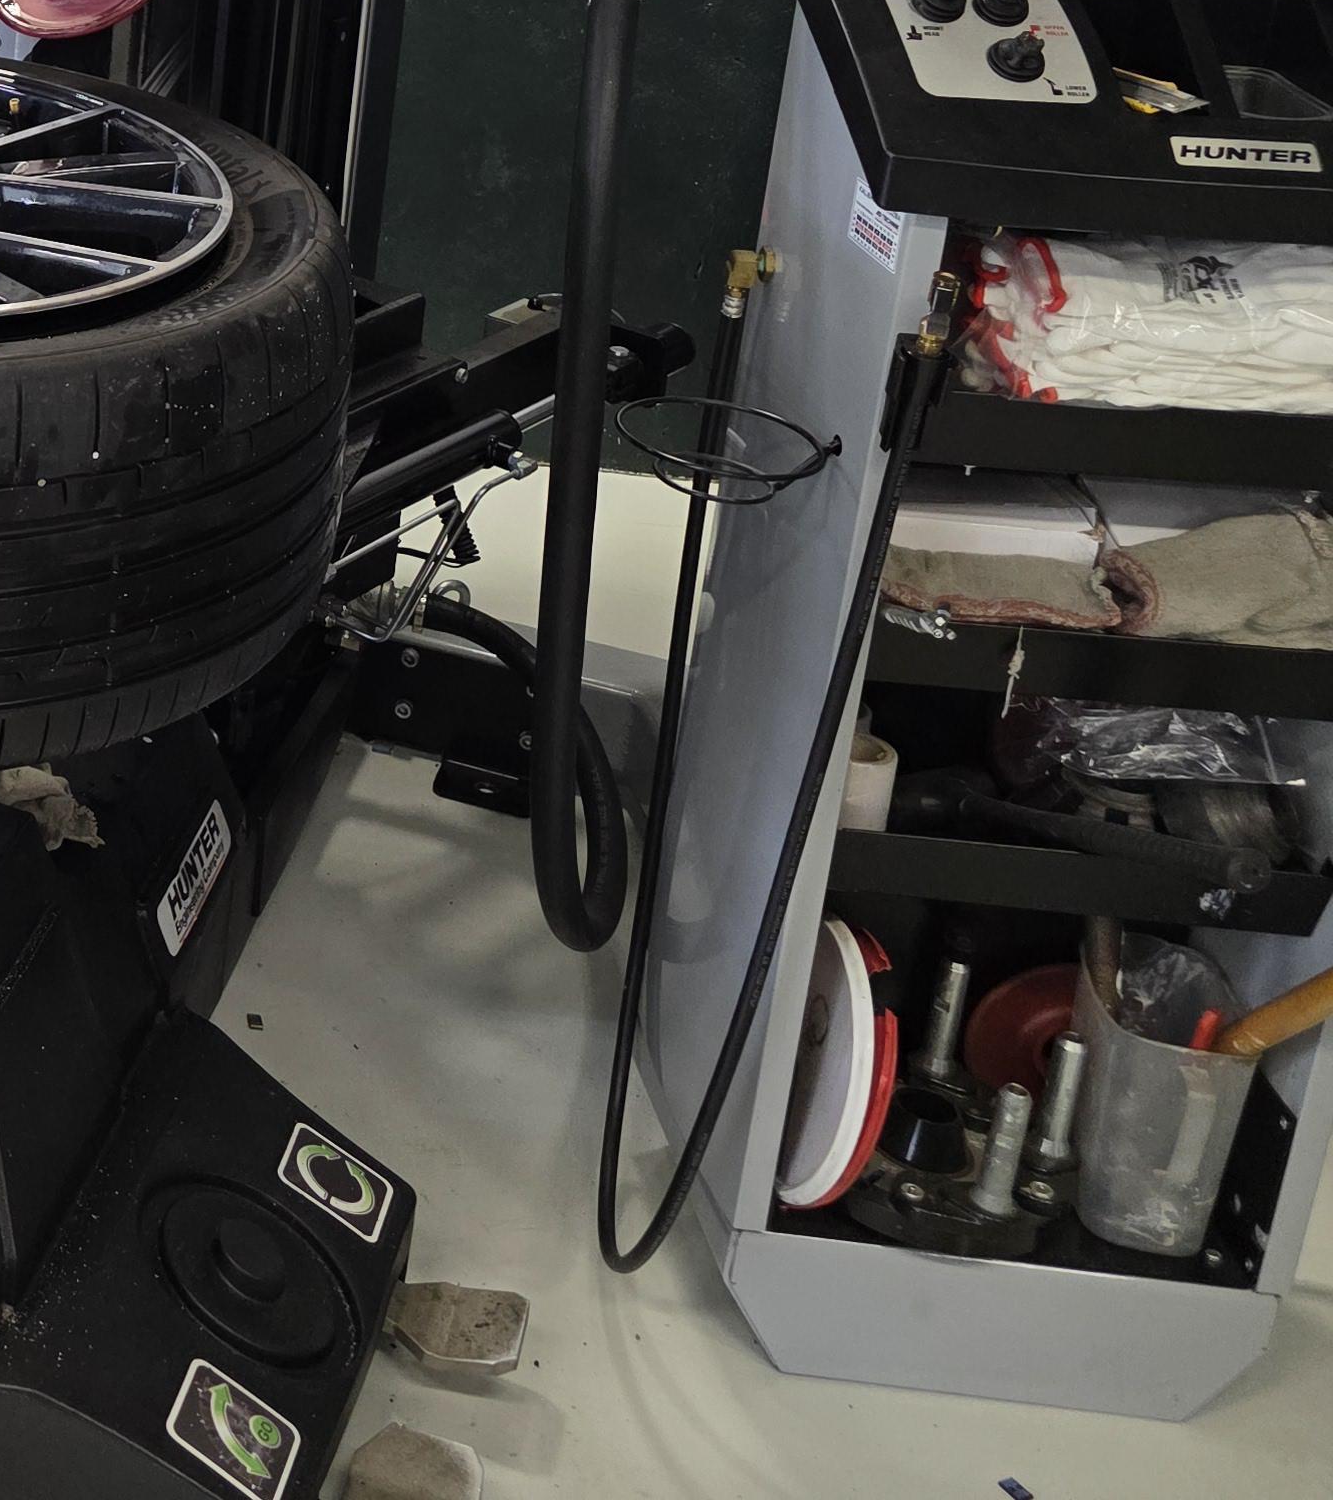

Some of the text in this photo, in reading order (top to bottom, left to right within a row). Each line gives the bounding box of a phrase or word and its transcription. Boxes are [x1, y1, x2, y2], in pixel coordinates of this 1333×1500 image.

[1180, 145, 1311, 164] HUNTER
[166, 811, 221, 922] HUNTER
[257, 1421, 273, 1442] GO
